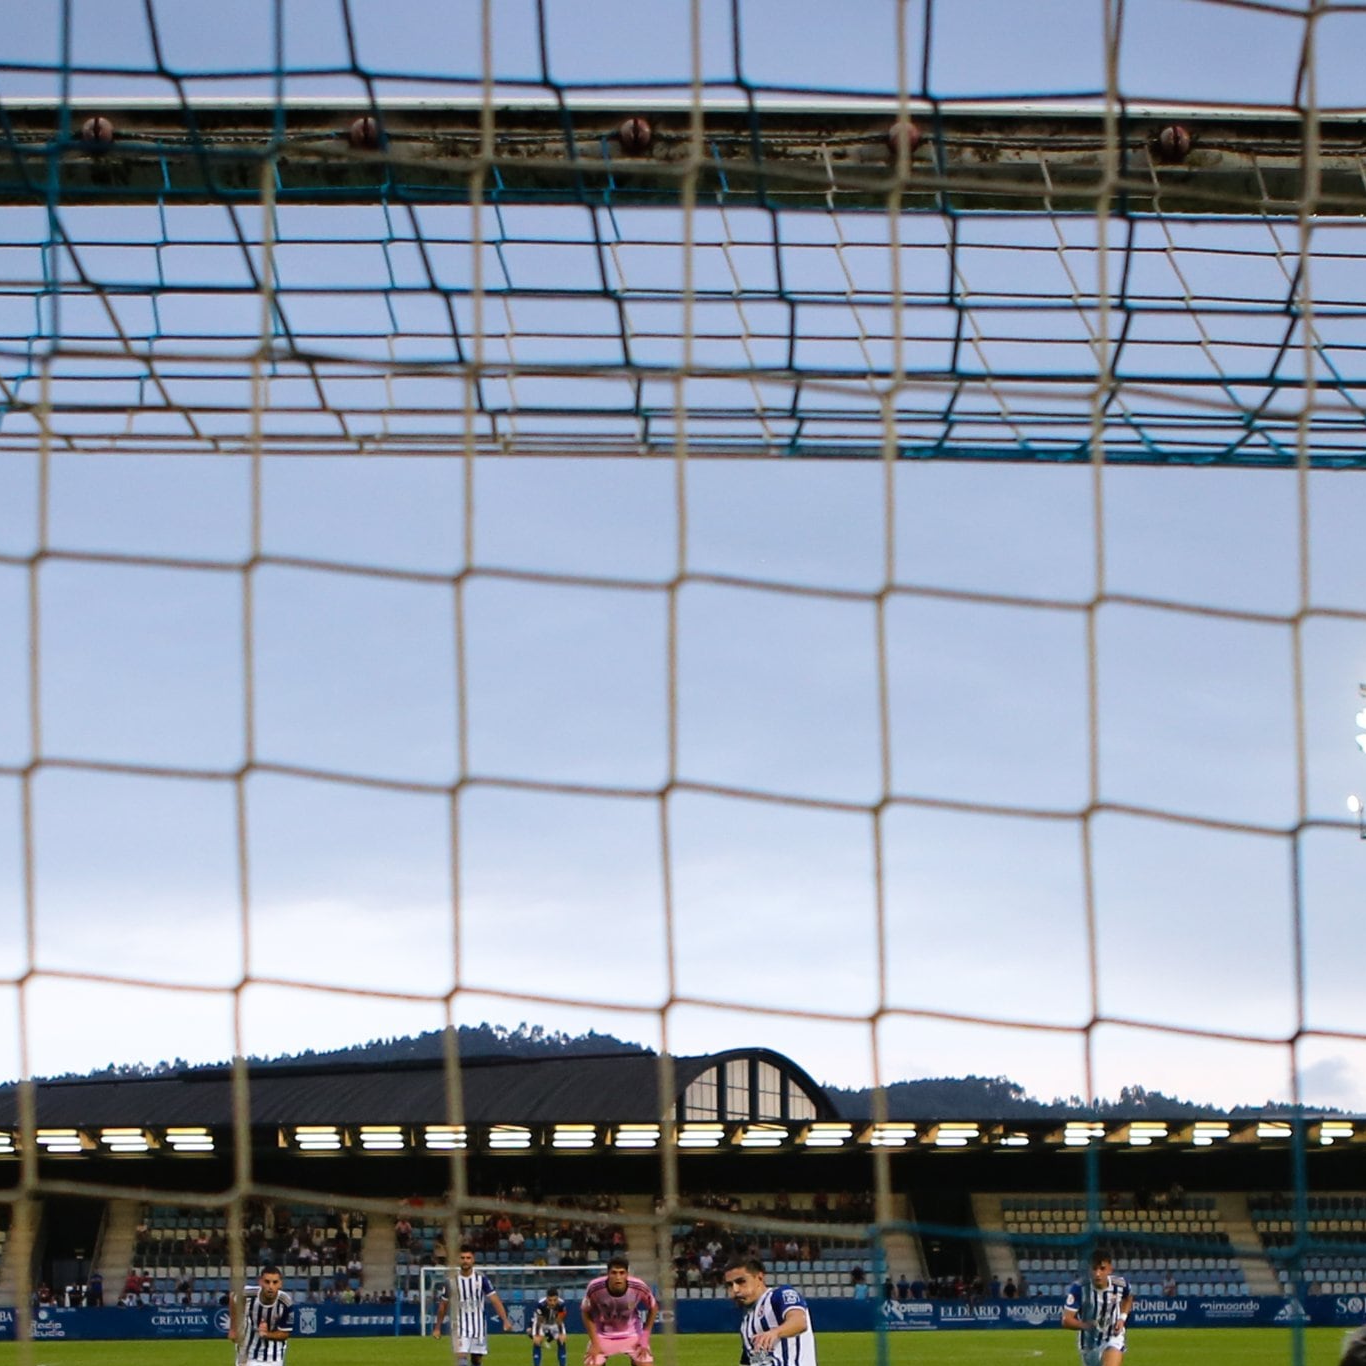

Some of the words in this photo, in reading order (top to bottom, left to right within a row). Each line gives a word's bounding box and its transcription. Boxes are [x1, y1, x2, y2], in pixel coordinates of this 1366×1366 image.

[940, 1305, 958, 1317] EL
[1132, 1299, 1188, 1312] RÜNBLAU
[151, 1315, 209, 1326] CREATREX
